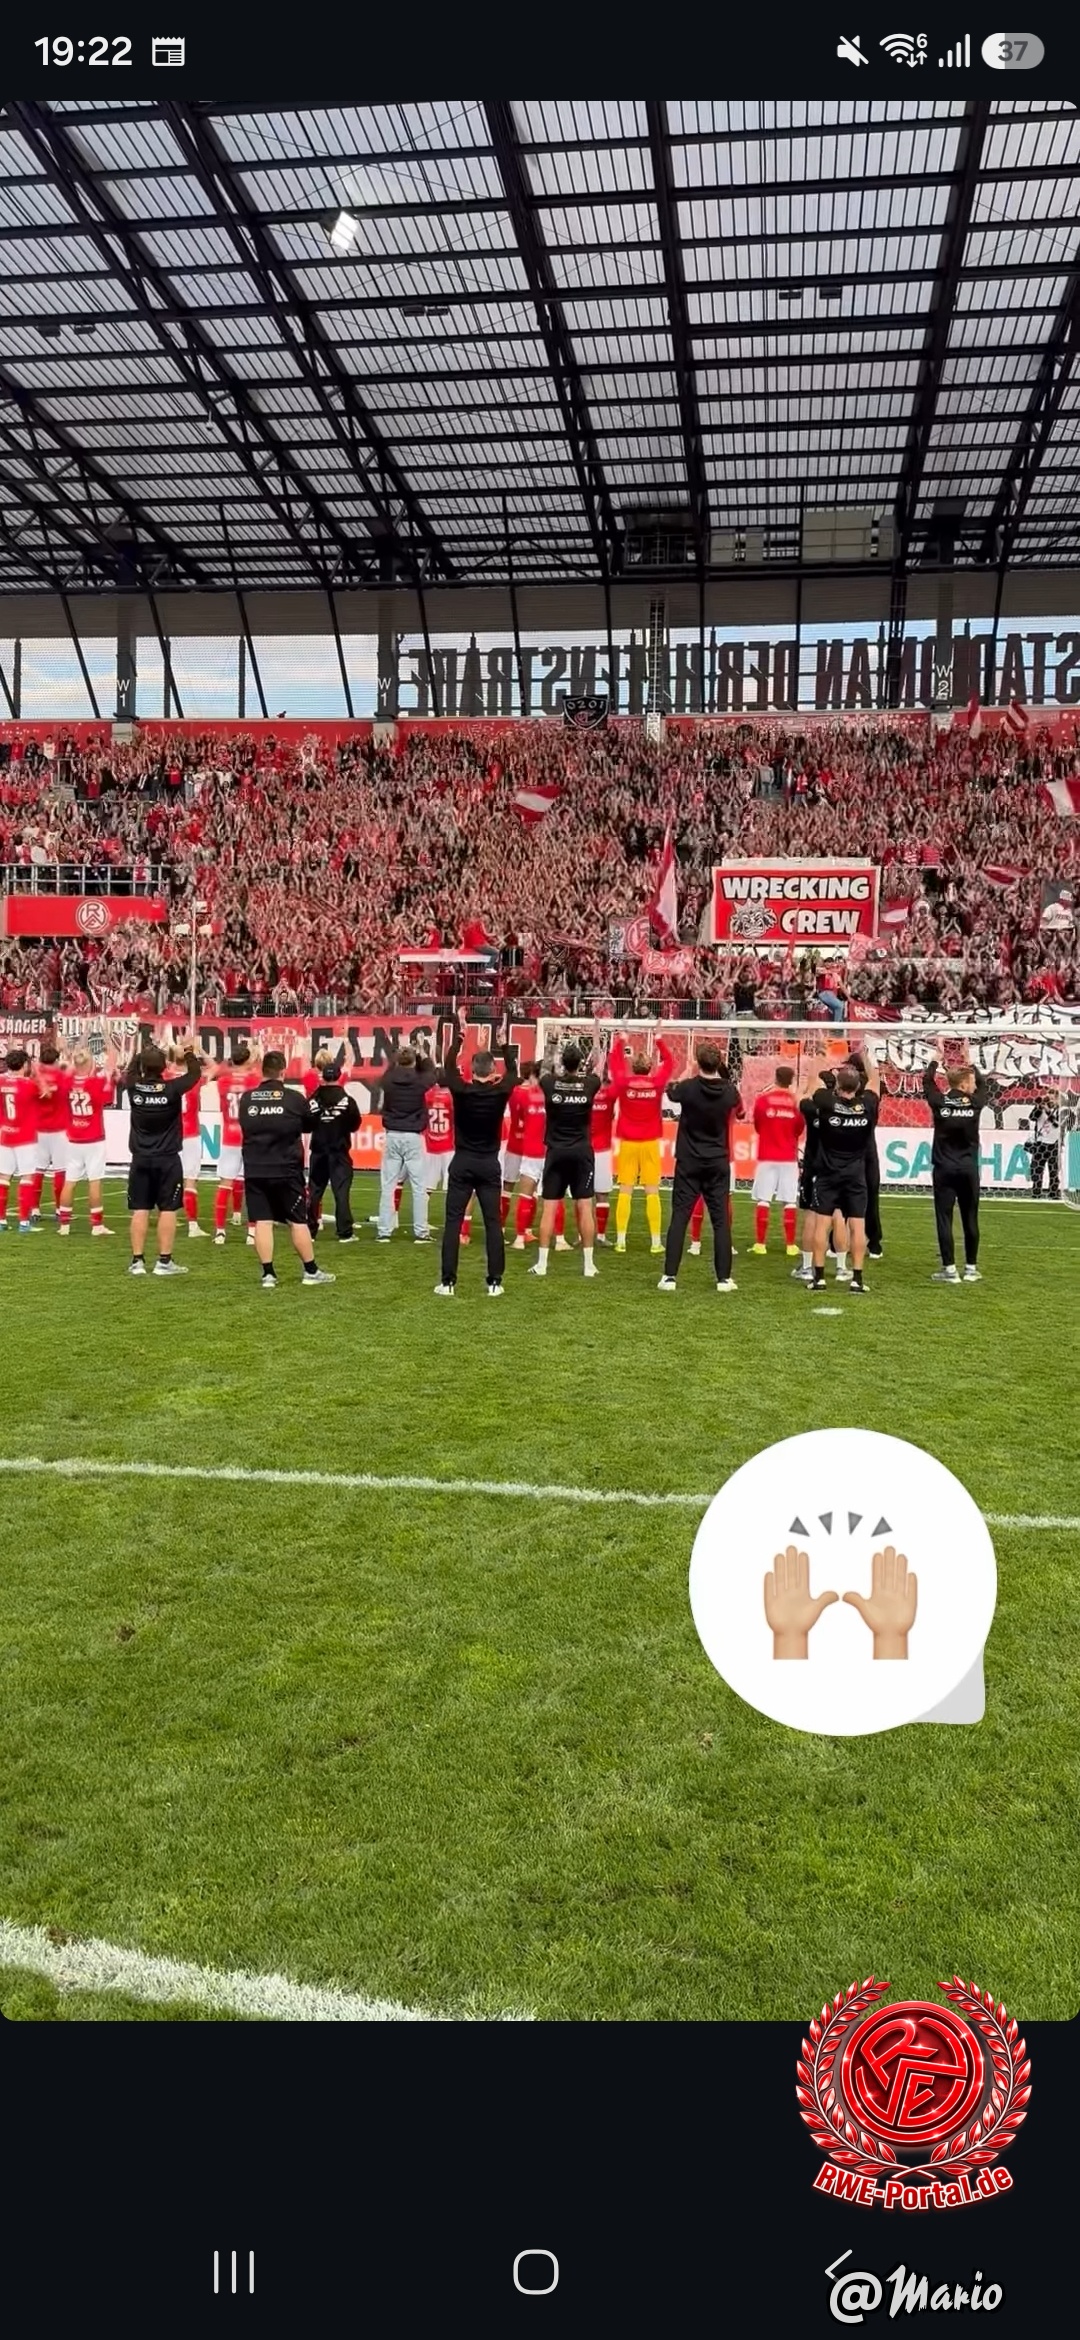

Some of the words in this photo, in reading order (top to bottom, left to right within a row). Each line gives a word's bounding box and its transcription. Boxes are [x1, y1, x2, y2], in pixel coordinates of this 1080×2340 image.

[721, 875, 870, 900] WRECKING
[780, 907, 861, 934] CREW
[5, 1093, 16, 1120] 6
[69, 1092, 93, 1116] 22
[144, 1096, 168, 1105] JAKO
[563, 1096, 588, 1104] JAKO
[259, 1106, 284, 1116] JAKO
[951, 1109, 975, 1118] JAKO
[427, 1109, 450, 1134] 25
[842, 1117, 868, 1127] JAKO
